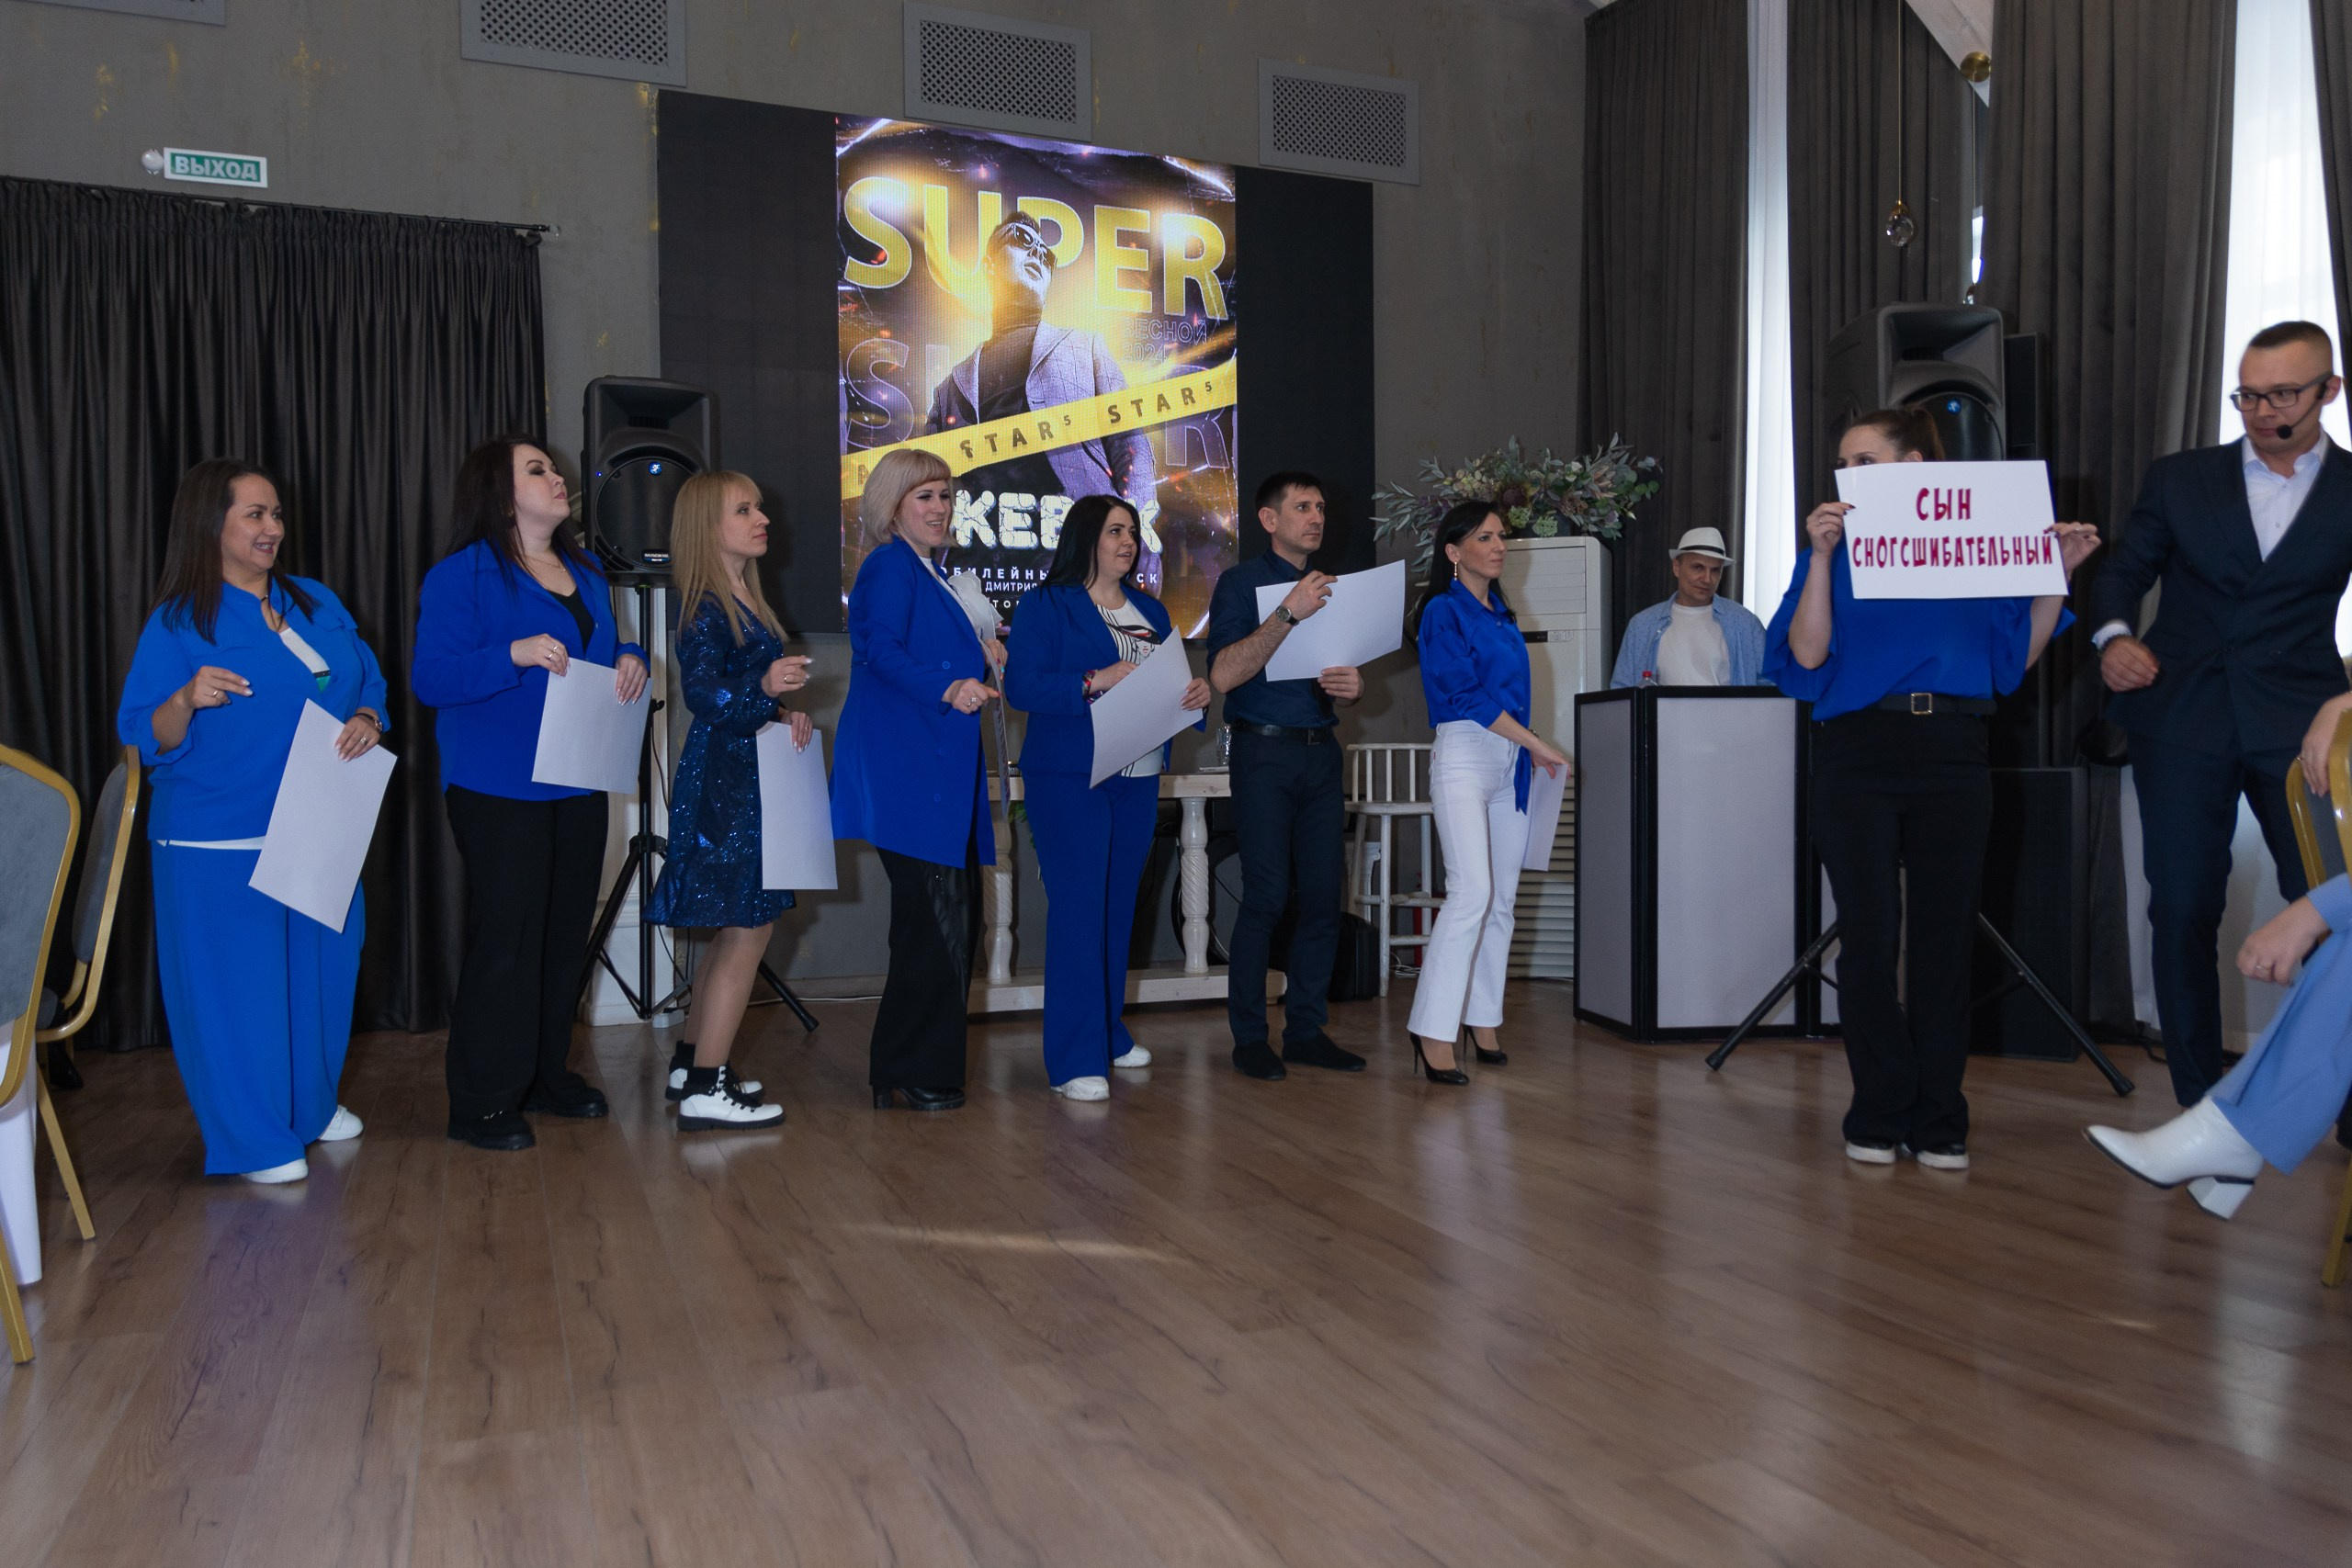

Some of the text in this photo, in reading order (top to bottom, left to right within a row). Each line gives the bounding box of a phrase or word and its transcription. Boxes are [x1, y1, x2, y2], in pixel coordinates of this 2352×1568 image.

[175, 155, 257, 181] ВЫХОД
[843, 175, 1229, 321] SUPER
[1122, 342, 1168, 364] 2024
[1916, 487, 1972, 521] СЫН
[1852, 531, 2052, 569] СНОГСШИБАТЕЛЬНЫЙ
